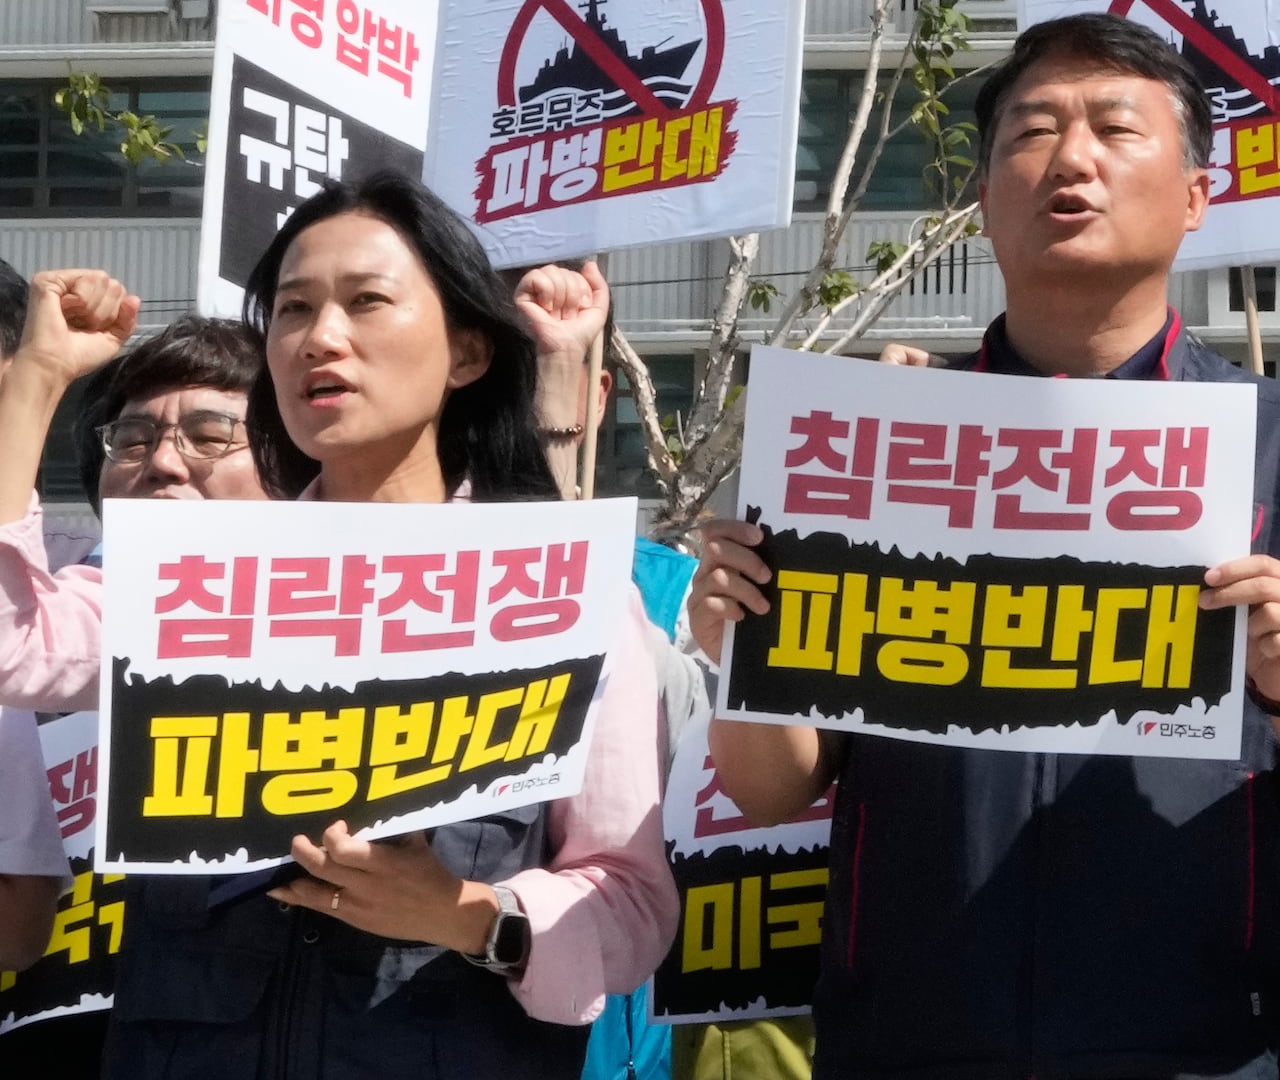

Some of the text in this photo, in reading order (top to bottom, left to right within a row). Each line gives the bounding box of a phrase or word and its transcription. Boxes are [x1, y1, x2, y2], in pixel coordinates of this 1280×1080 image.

[240, 86, 349, 199] 규탄
[486, 107, 723, 210] 파병반대
[491, 94, 605, 138] 호르무즈
[784, 410, 1209, 531] 침략전쟁
[154, 541, 589, 659] 침략전쟁
[767, 569, 1201, 690] 파병반대
[142, 672, 573, 818] 파병반대
